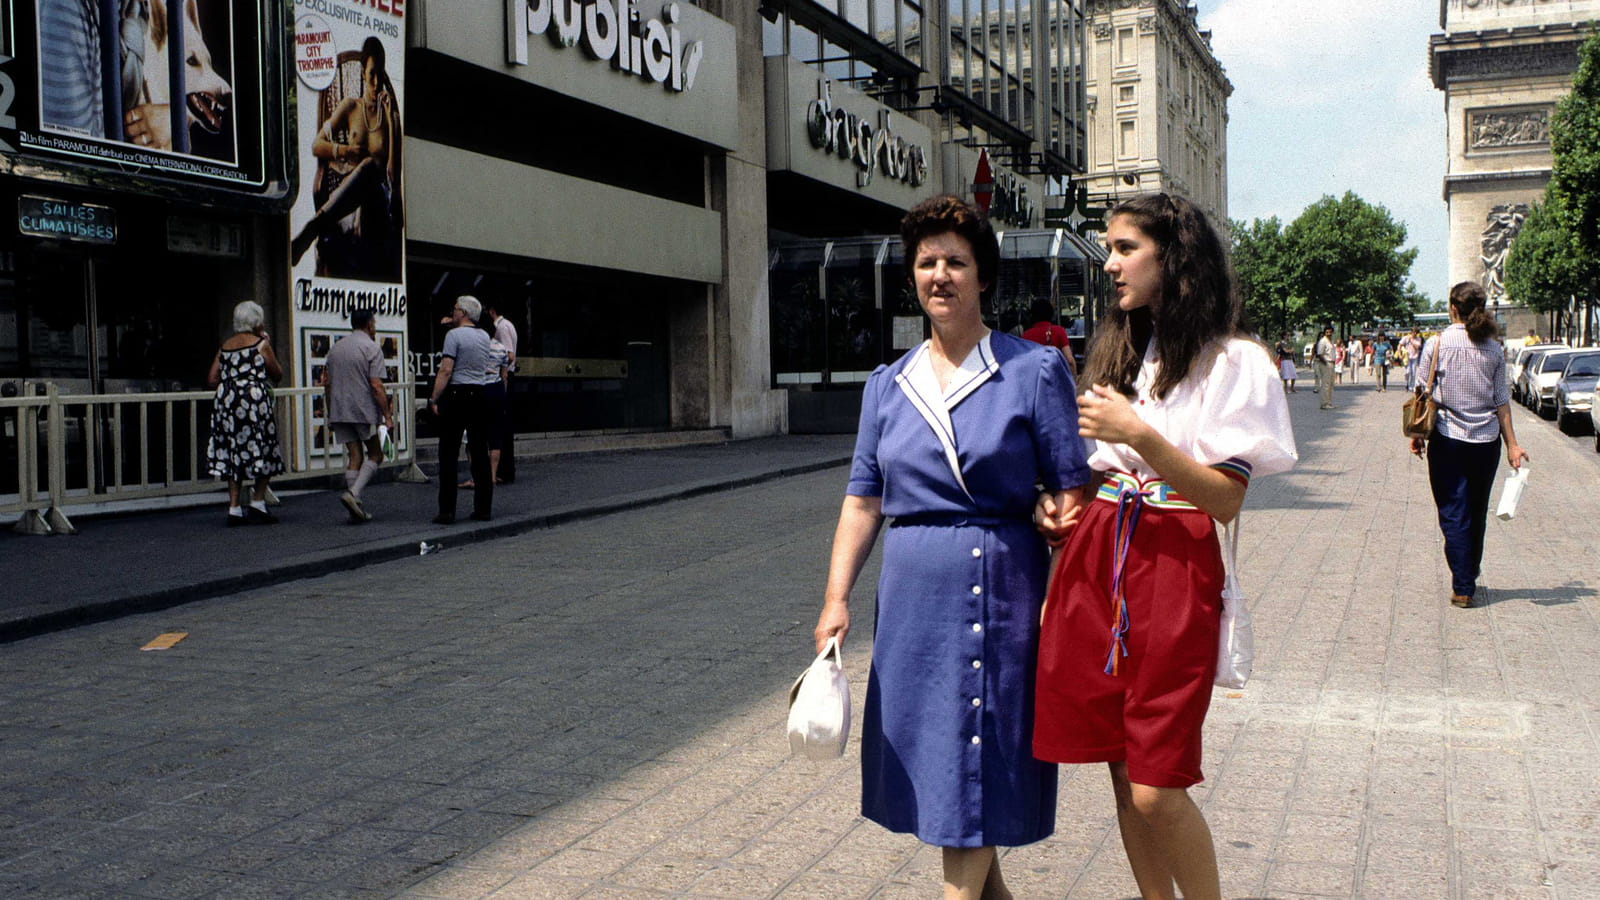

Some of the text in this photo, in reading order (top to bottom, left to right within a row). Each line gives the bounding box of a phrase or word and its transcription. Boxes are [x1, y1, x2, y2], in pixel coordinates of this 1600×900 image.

[373, 18, 399, 38] PARIS
[306, 44, 321, 57] CITY
[297, 56, 335, 72] TRIOMPHE
[26, 132, 37, 144] Un
[53, 138, 98, 155] PARAMOUNT
[160, 157, 202, 173] INTERNATIONAL
[202, 165, 244, 179] CORPORATION
[296, 278, 406, 320] Emmanuelle
